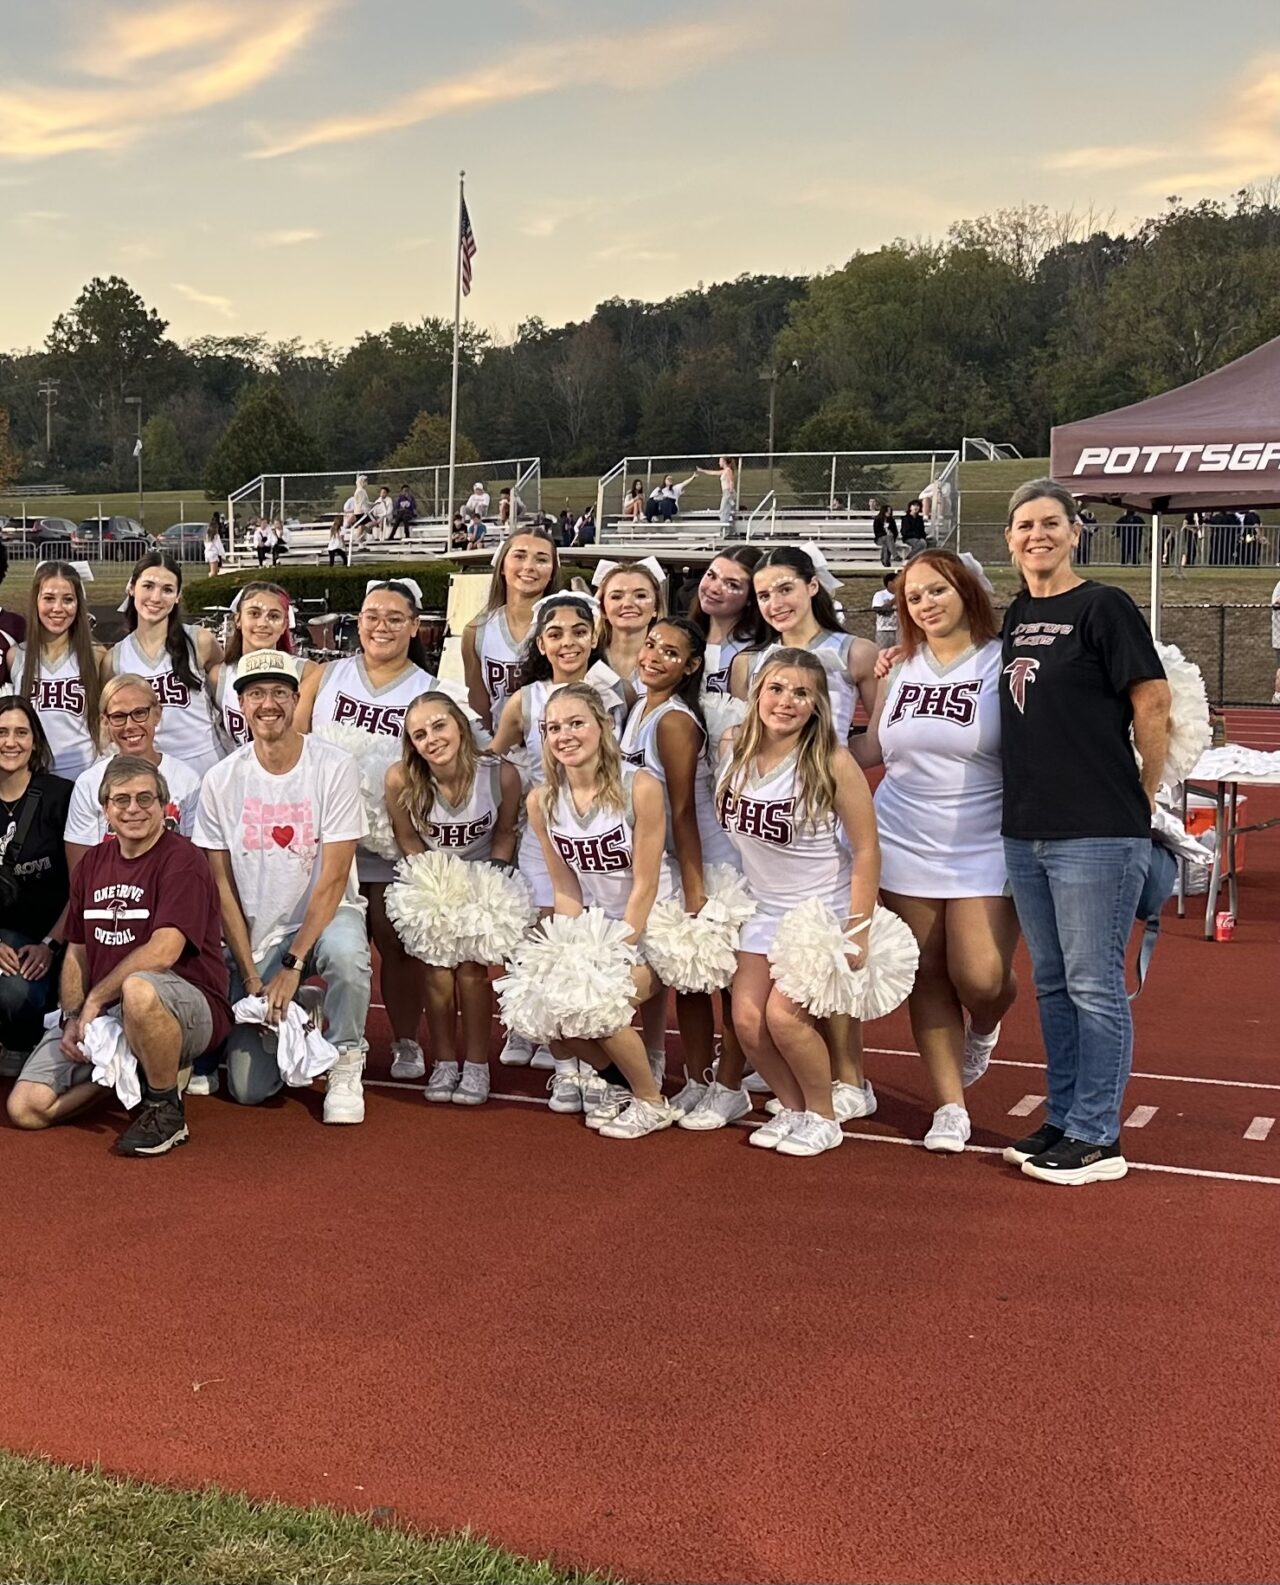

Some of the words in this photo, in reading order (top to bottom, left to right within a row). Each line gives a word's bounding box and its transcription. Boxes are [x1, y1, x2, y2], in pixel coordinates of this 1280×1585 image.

[143, 669, 192, 709] HS
[332, 689, 409, 738] PHS
[886, 679, 985, 728] PHS
[717, 785, 797, 848] PHS
[550, 824, 632, 875] PHS
[93, 885, 117, 903] ONE
